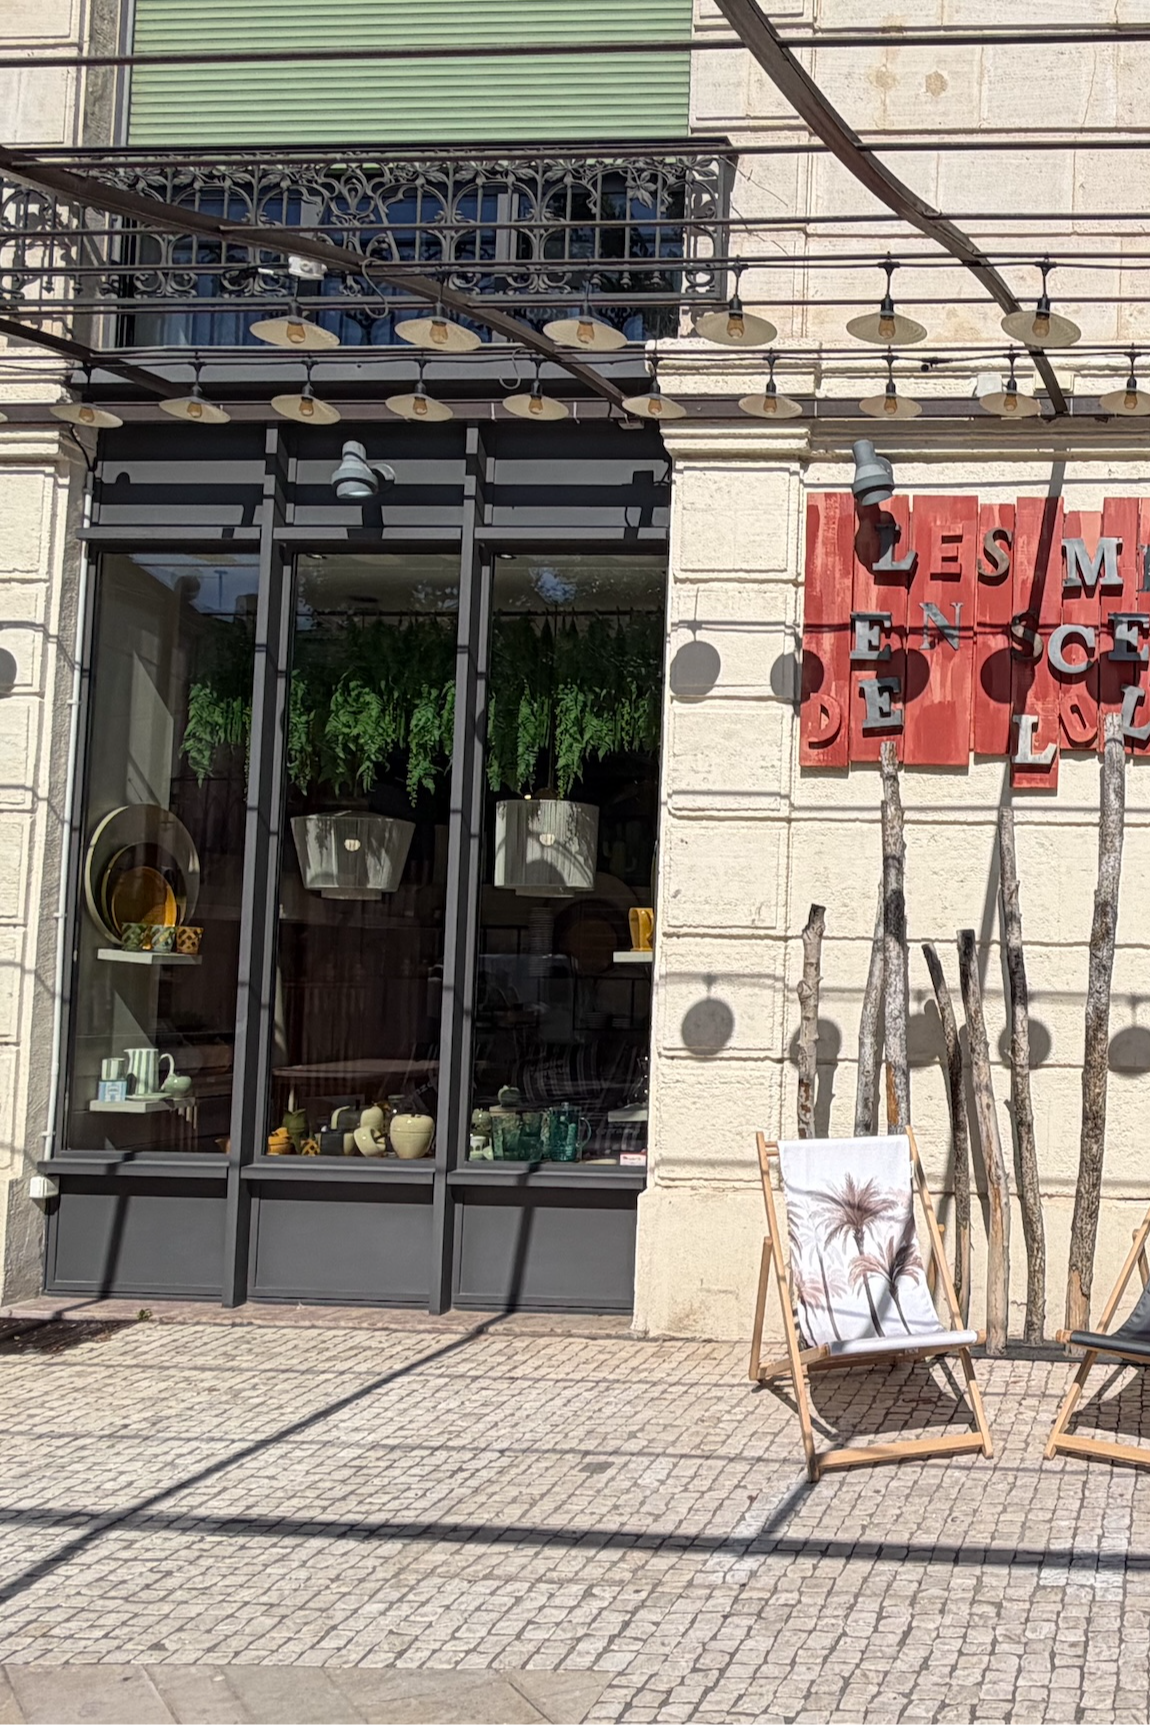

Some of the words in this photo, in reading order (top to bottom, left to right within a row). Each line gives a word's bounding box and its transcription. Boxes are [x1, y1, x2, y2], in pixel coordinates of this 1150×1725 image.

[872, 523, 1014, 586] LES
[850, 602, 963, 660] EN
[806, 677, 903, 750] DE
